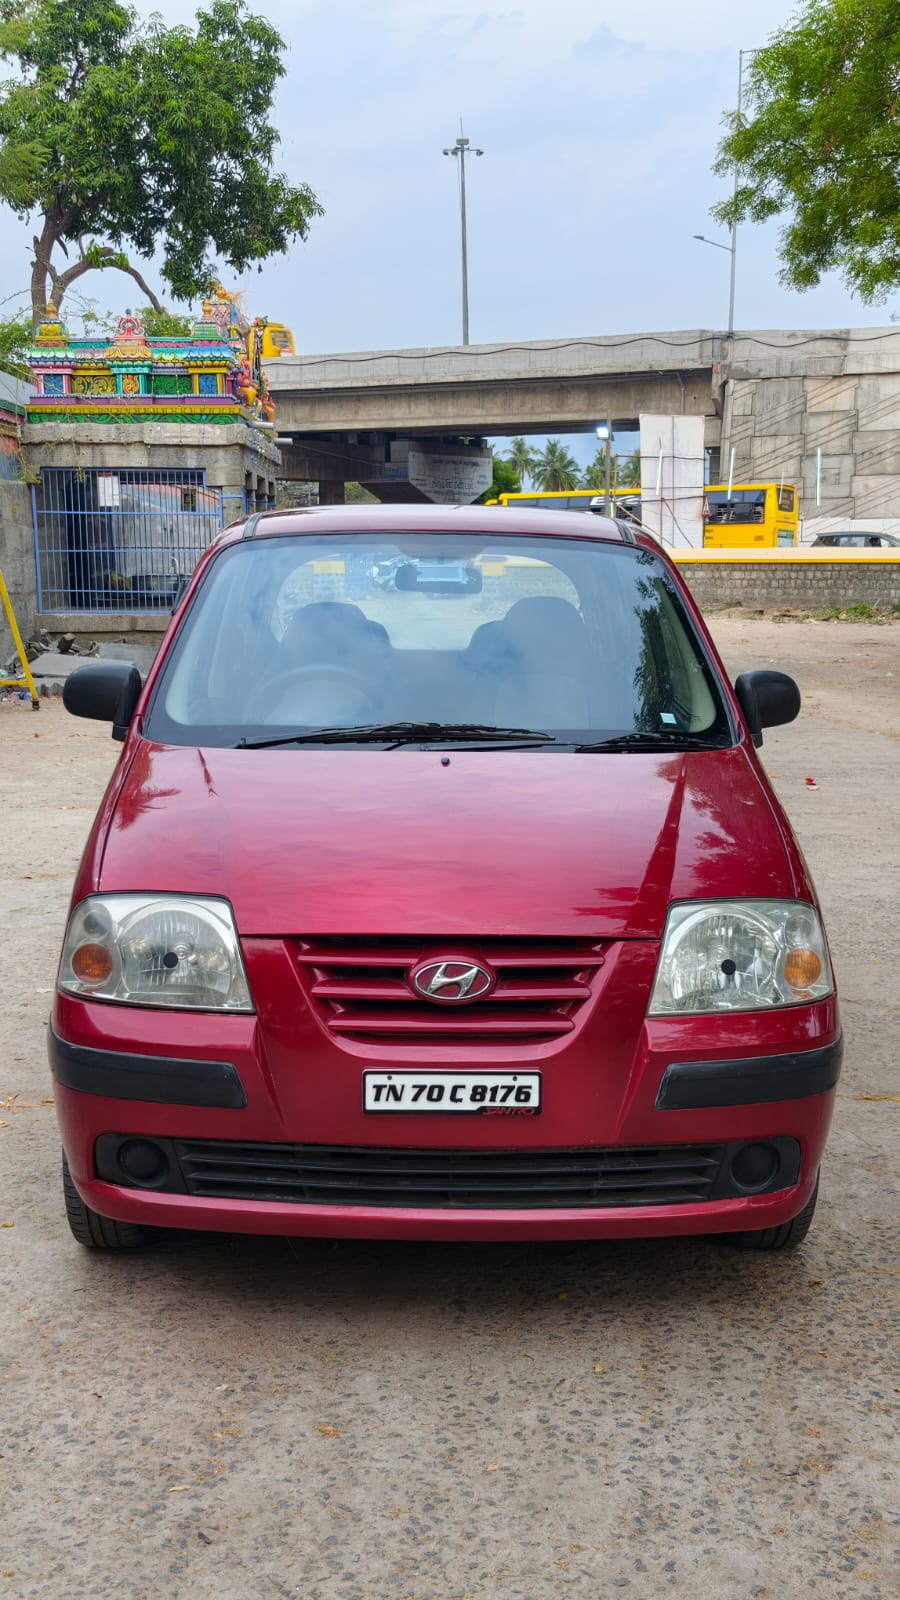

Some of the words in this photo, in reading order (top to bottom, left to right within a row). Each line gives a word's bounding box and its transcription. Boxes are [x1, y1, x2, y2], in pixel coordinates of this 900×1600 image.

[372, 1084, 405, 1102] TN
[411, 1084, 445, 1102] 70
[450, 1084, 466, 1103] C
[469, 1085, 533, 1103] 8176
[483, 1107, 536, 1116] SANTRO
